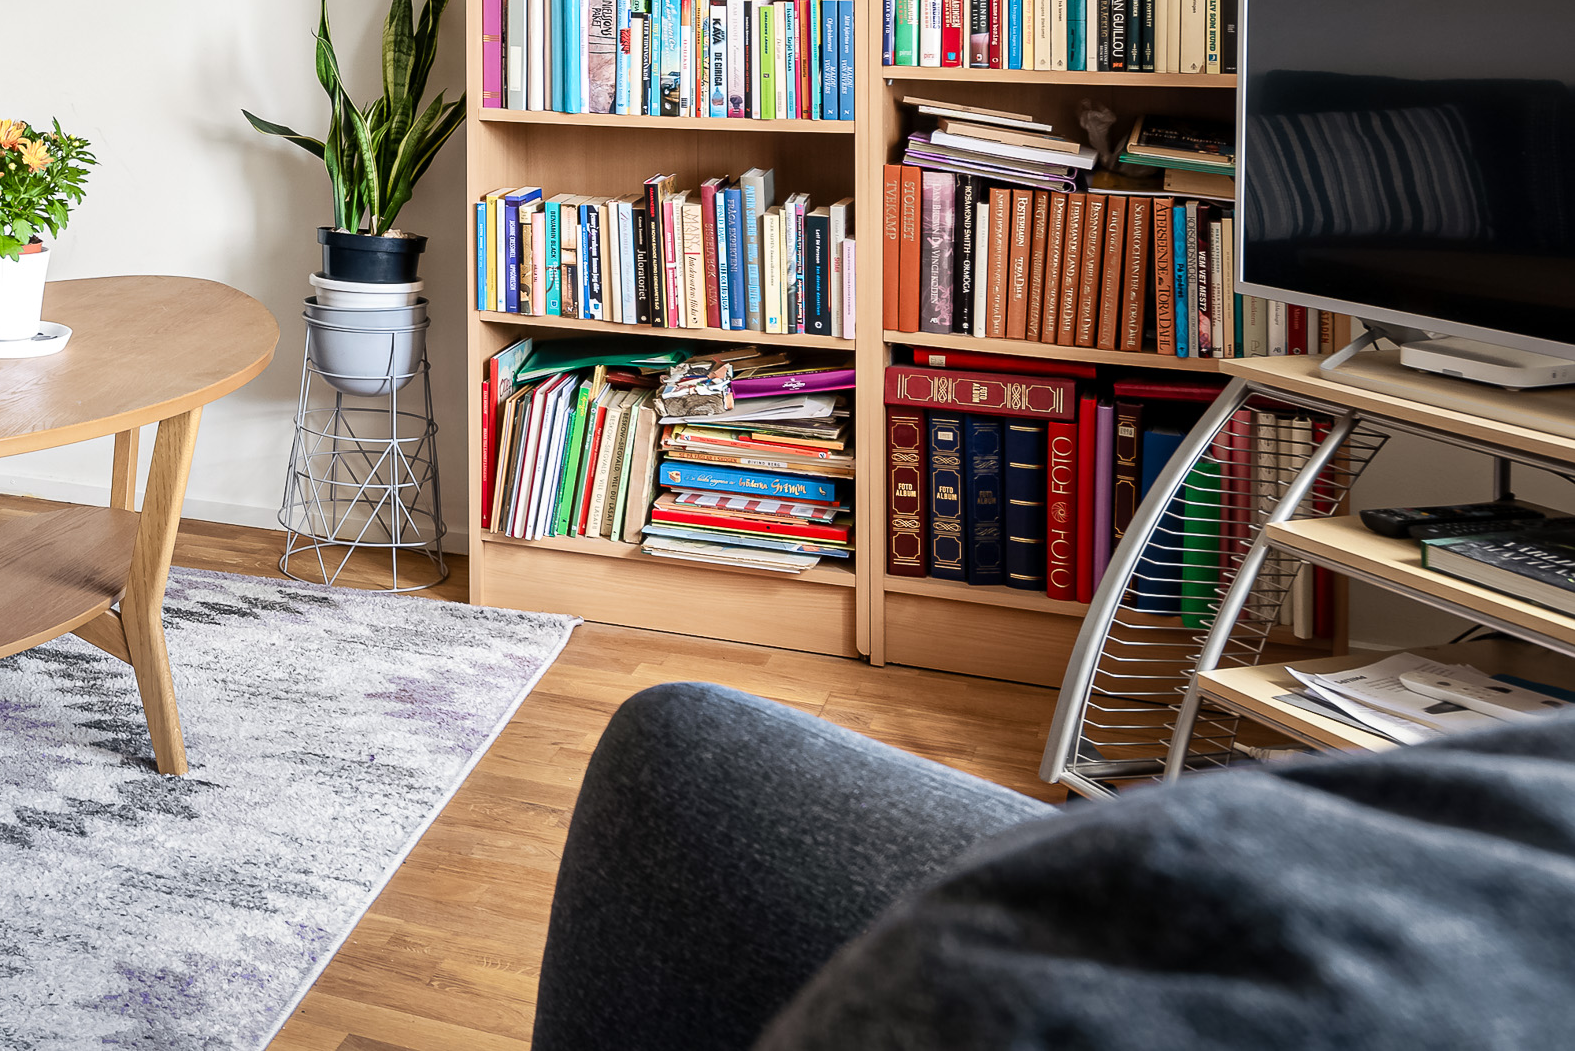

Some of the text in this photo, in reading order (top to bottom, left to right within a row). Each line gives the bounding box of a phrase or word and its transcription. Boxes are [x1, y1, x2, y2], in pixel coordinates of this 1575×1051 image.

[592, 7, 601, 28] PAKET
[885, 13, 892, 22] OM
[1100, 12, 1108, 38] ÄCKLIG
[1113, 13, 1125, 57] GUILLOU
[715, 52, 722, 61] DE
[886, 180, 897, 240] TVEKAMP
[903, 181, 915, 242] STOLTHET
[691, 214, 700, 247] MARY
[963, 185, 972, 293] ROSAMOND SMITH ORMÖGA
[1014, 196, 1028, 301] FOSTERBARN TORA DAHL
[637, 249, 647, 301] Juloratoriet
[705, 223, 717, 307] SISSELA BOK ALVA
[1127, 204, 1144, 348] SOMMAR OCH VINTER TORA DAHL
[1176, 263, 1185, 298] På spåret
[1158, 285, 1171, 315] TORA
[1158, 315, 1172, 350] DAHL
[972, 382, 980, 403] ALBUM
[1052, 436, 1072, 494] FOTO
[738, 478, 807, 495] bröderna Grimm
[895, 489, 916, 498] ALBUM
[898, 483, 913, 491] FOTO
[936, 491, 957, 500] ALBUM
[939, 486, 954, 494] FOTO
[977, 496, 996, 504] ALBUM
[979, 490, 993, 498] FOTO
[1334, 675, 1368, 685] PHILIPS
